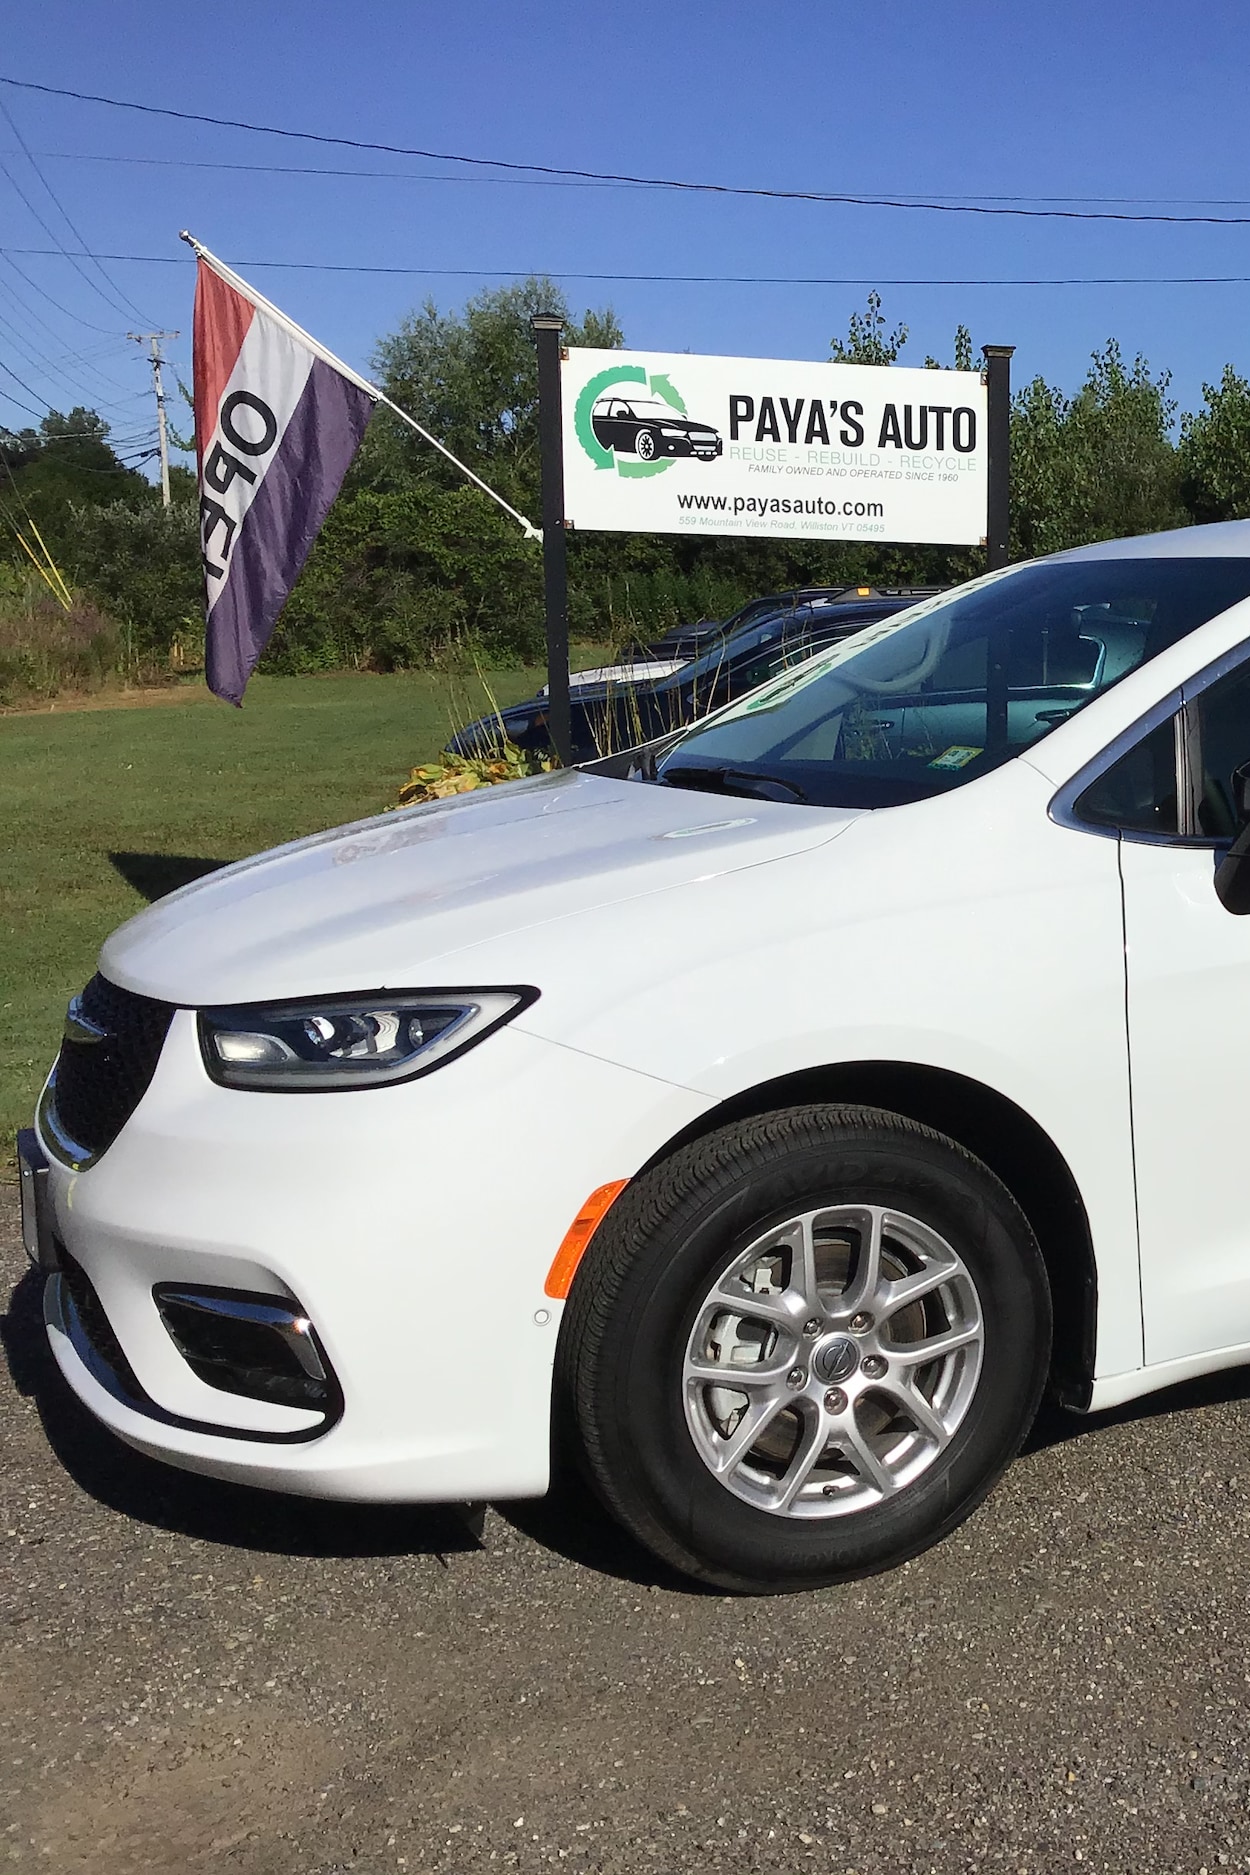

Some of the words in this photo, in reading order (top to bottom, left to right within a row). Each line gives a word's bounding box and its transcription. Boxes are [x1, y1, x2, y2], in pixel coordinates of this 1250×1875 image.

[729, 394, 864, 447] PAYA'S
[878, 403, 977, 453] AUTO
[729, 447, 788, 463] REUSE
[807, 450, 881, 467] REBUILD
[900, 455, 977, 471] RECYCLE
[748, 464, 783, 474] FAMILY
[785, 466, 824, 476] OWNED
[826, 467, 848, 477] AND
[850, 468, 903, 479] OPERATED
[905, 471, 935, 482] SINCE
[937, 472, 959, 483] 1960
[677, 494, 884, 517] www.payasauto.com
[679, 515, 697, 525] 559
[699, 517, 743, 528] Mountain
[745, 519, 767, 529] View
[801, 521, 839, 532] Williston
[842, 523, 855, 532] VT
[857, 523, 885, 533] 05495
